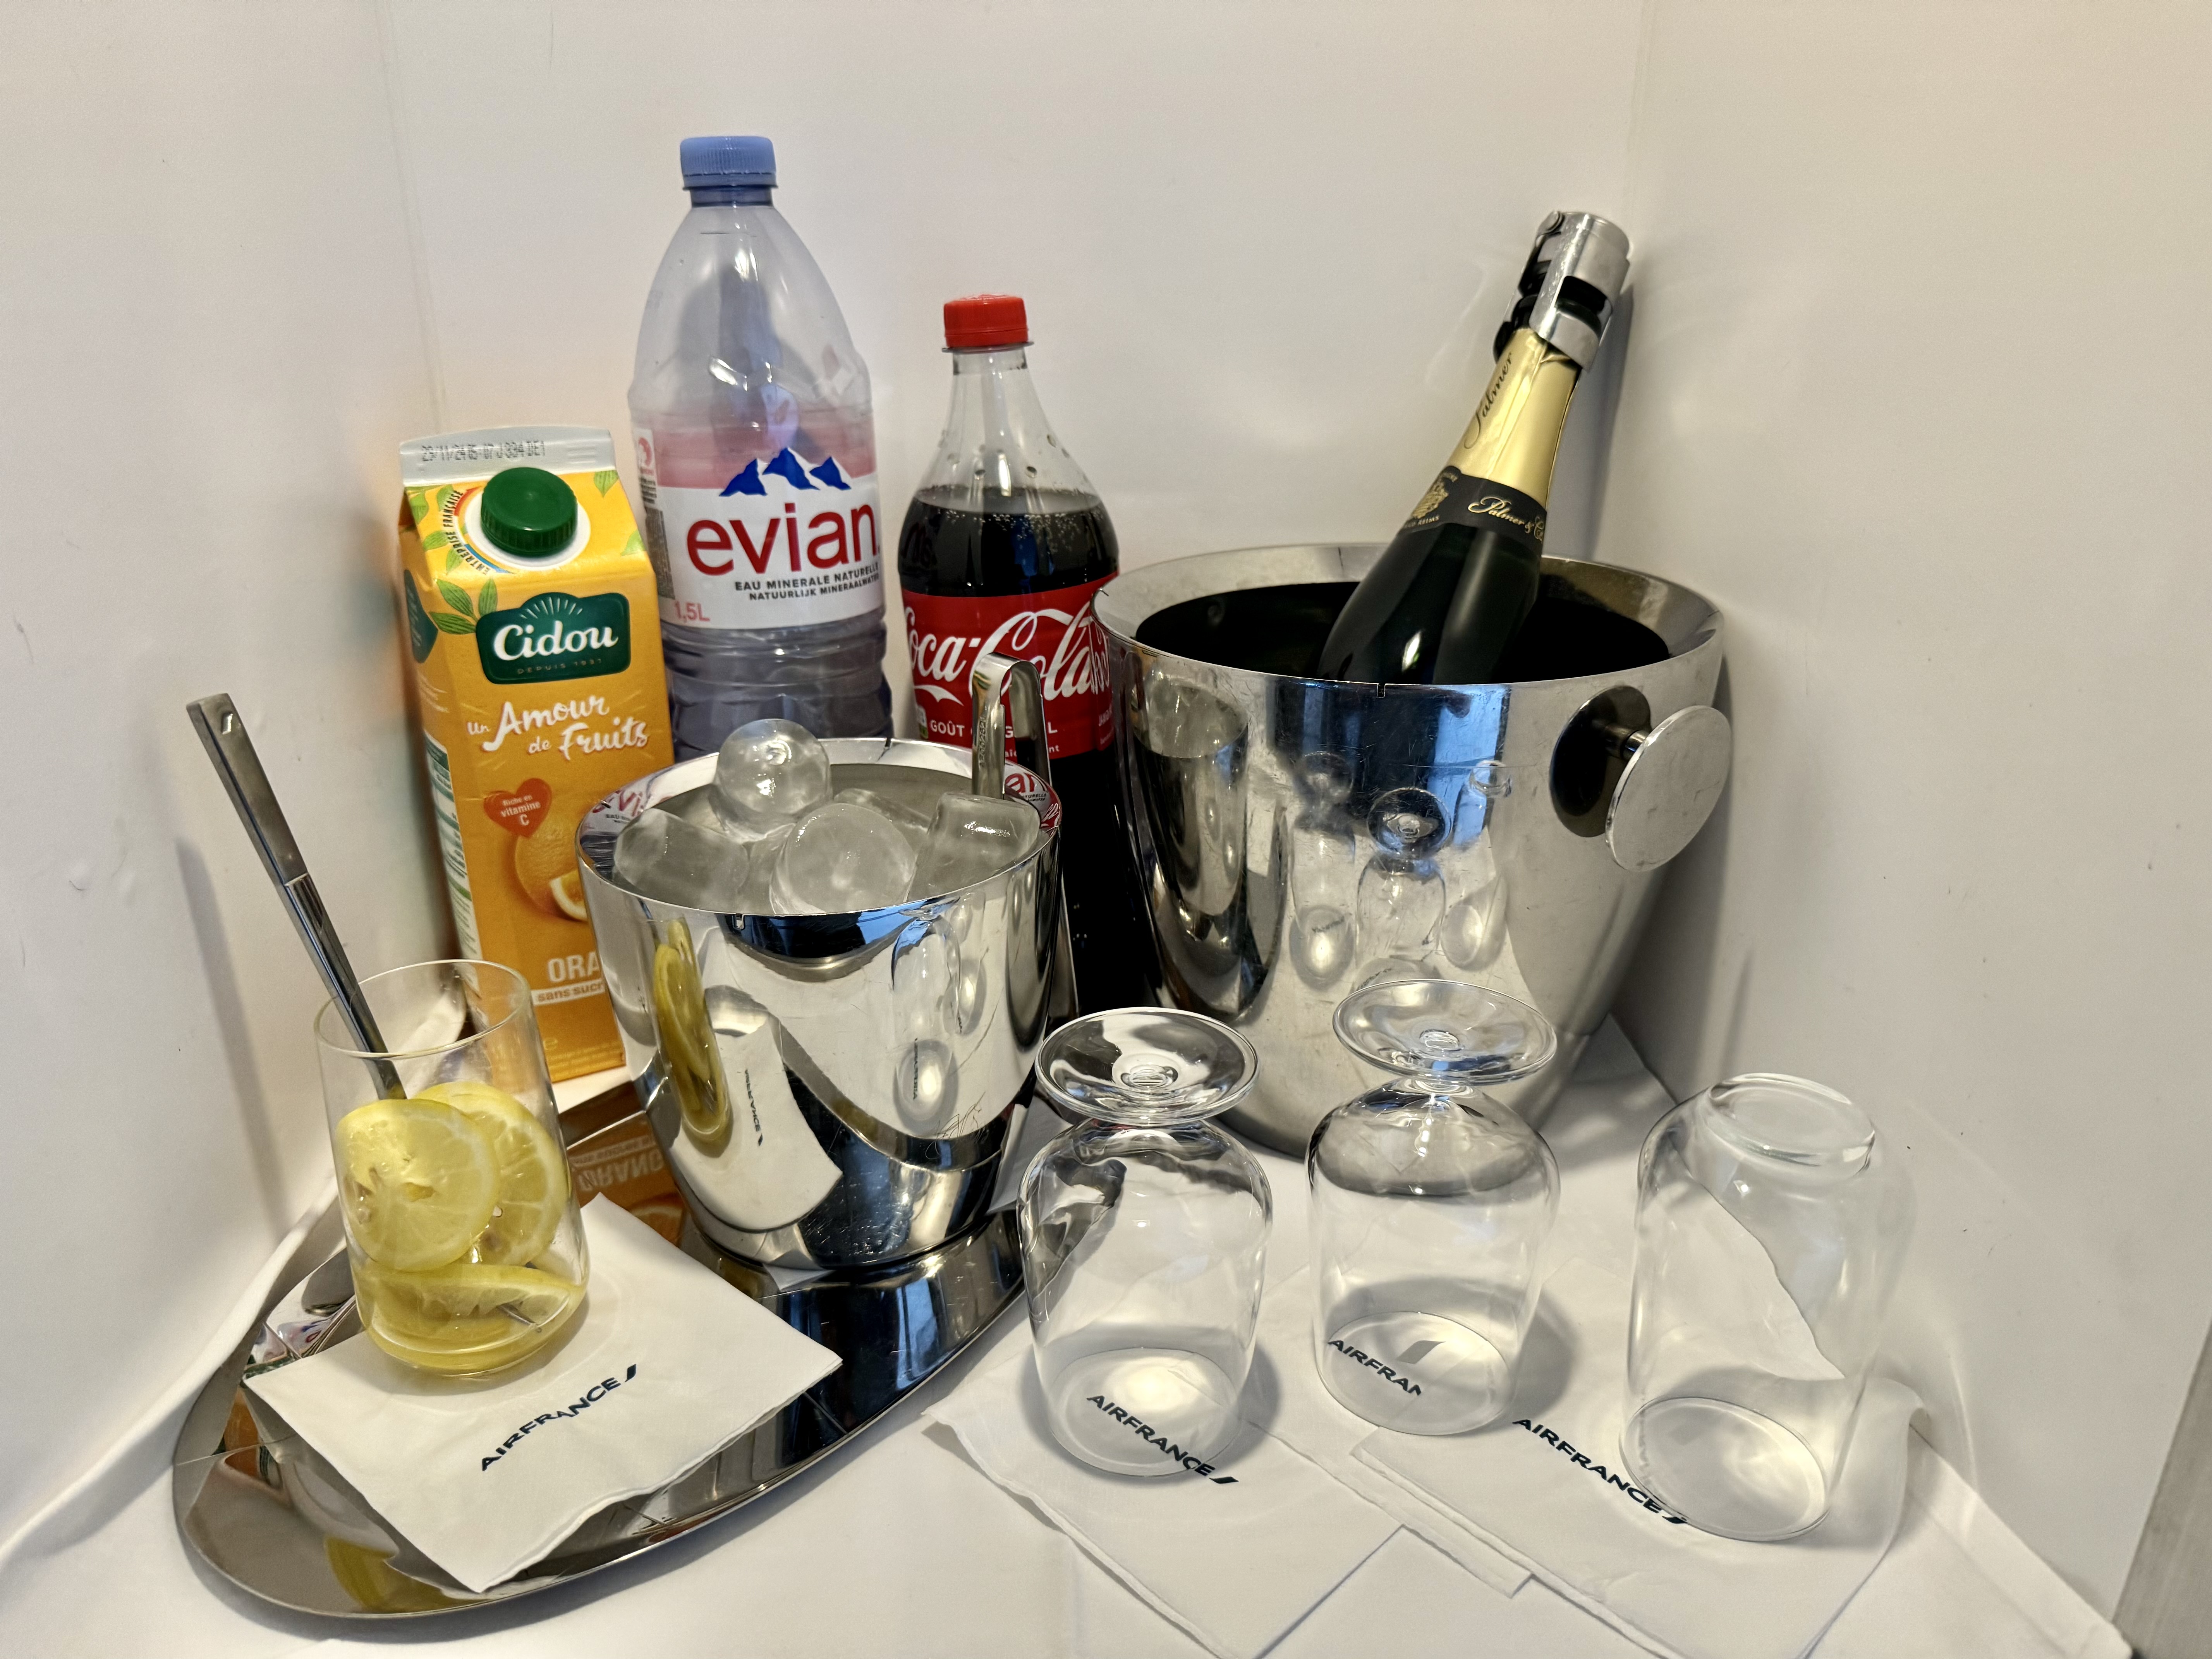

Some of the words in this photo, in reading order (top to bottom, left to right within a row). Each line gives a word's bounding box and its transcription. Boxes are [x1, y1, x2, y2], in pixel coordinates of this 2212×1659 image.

[446, 531, 491, 575] ENTREPRISE
[687, 503, 878, 575] evian
[735, 580, 761, 591] EAU
[767, 575, 830, 590] MINERALE
[749, 588, 817, 601] NATUURLIJK
[493, 620, 619, 661] Cidou
[517, 663, 566, 675] DEPUIS
[481, 695, 610, 752] Amour
[528, 736, 551, 754] de
[558, 717, 651, 761] Fruits
[930, 719, 965, 737] GOÛT
[500, 801, 541, 817] vitamine
[520, 814, 529, 826] C
[548, 951, 600, 982] ORA
[538, 988, 571, 1002] sans
[573, 982, 603, 996] sucr
[1327, 1340, 1422, 1396] AIRFRAN
[482, 1377, 621, 1472] AIRFRANCE
[1086, 1395, 1216, 1476] AIRFRANCE
[1512, 1419, 1662, 1514] AIRFRANCE
